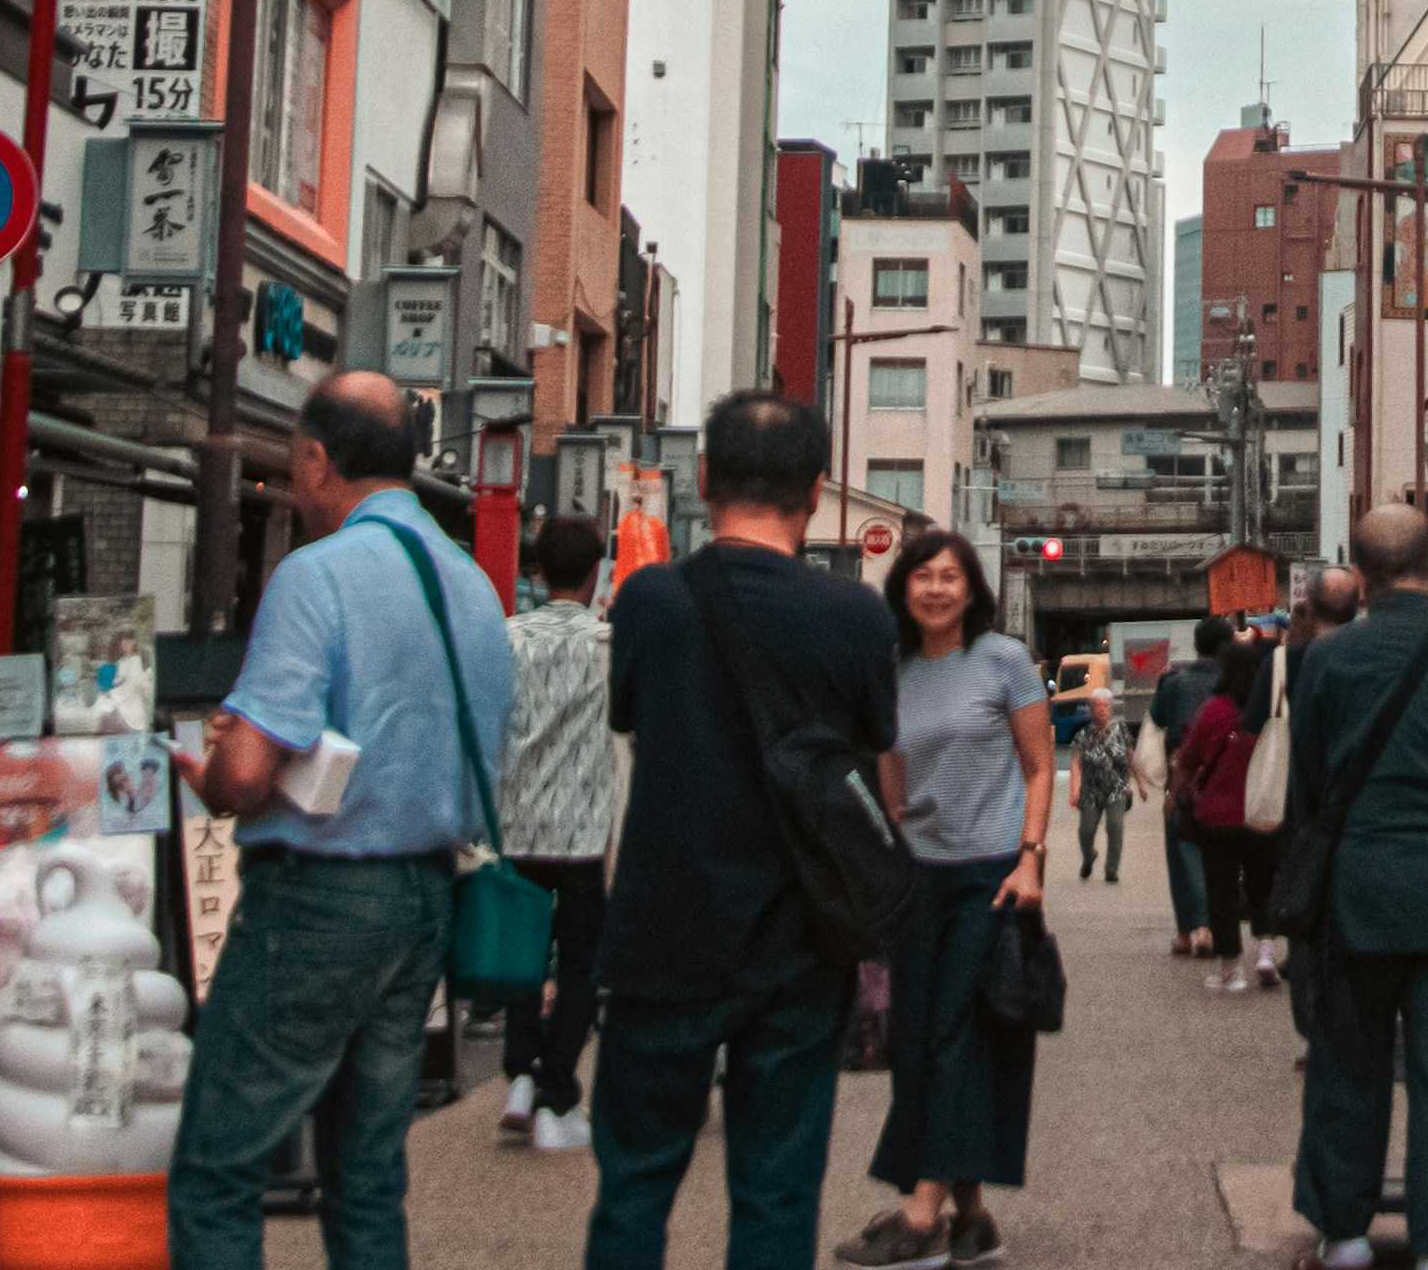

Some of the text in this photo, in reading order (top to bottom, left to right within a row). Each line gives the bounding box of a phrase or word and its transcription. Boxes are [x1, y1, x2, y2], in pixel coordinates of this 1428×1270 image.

[132, 75, 193, 111] 15分
[119, 300, 181, 323] 写真館
